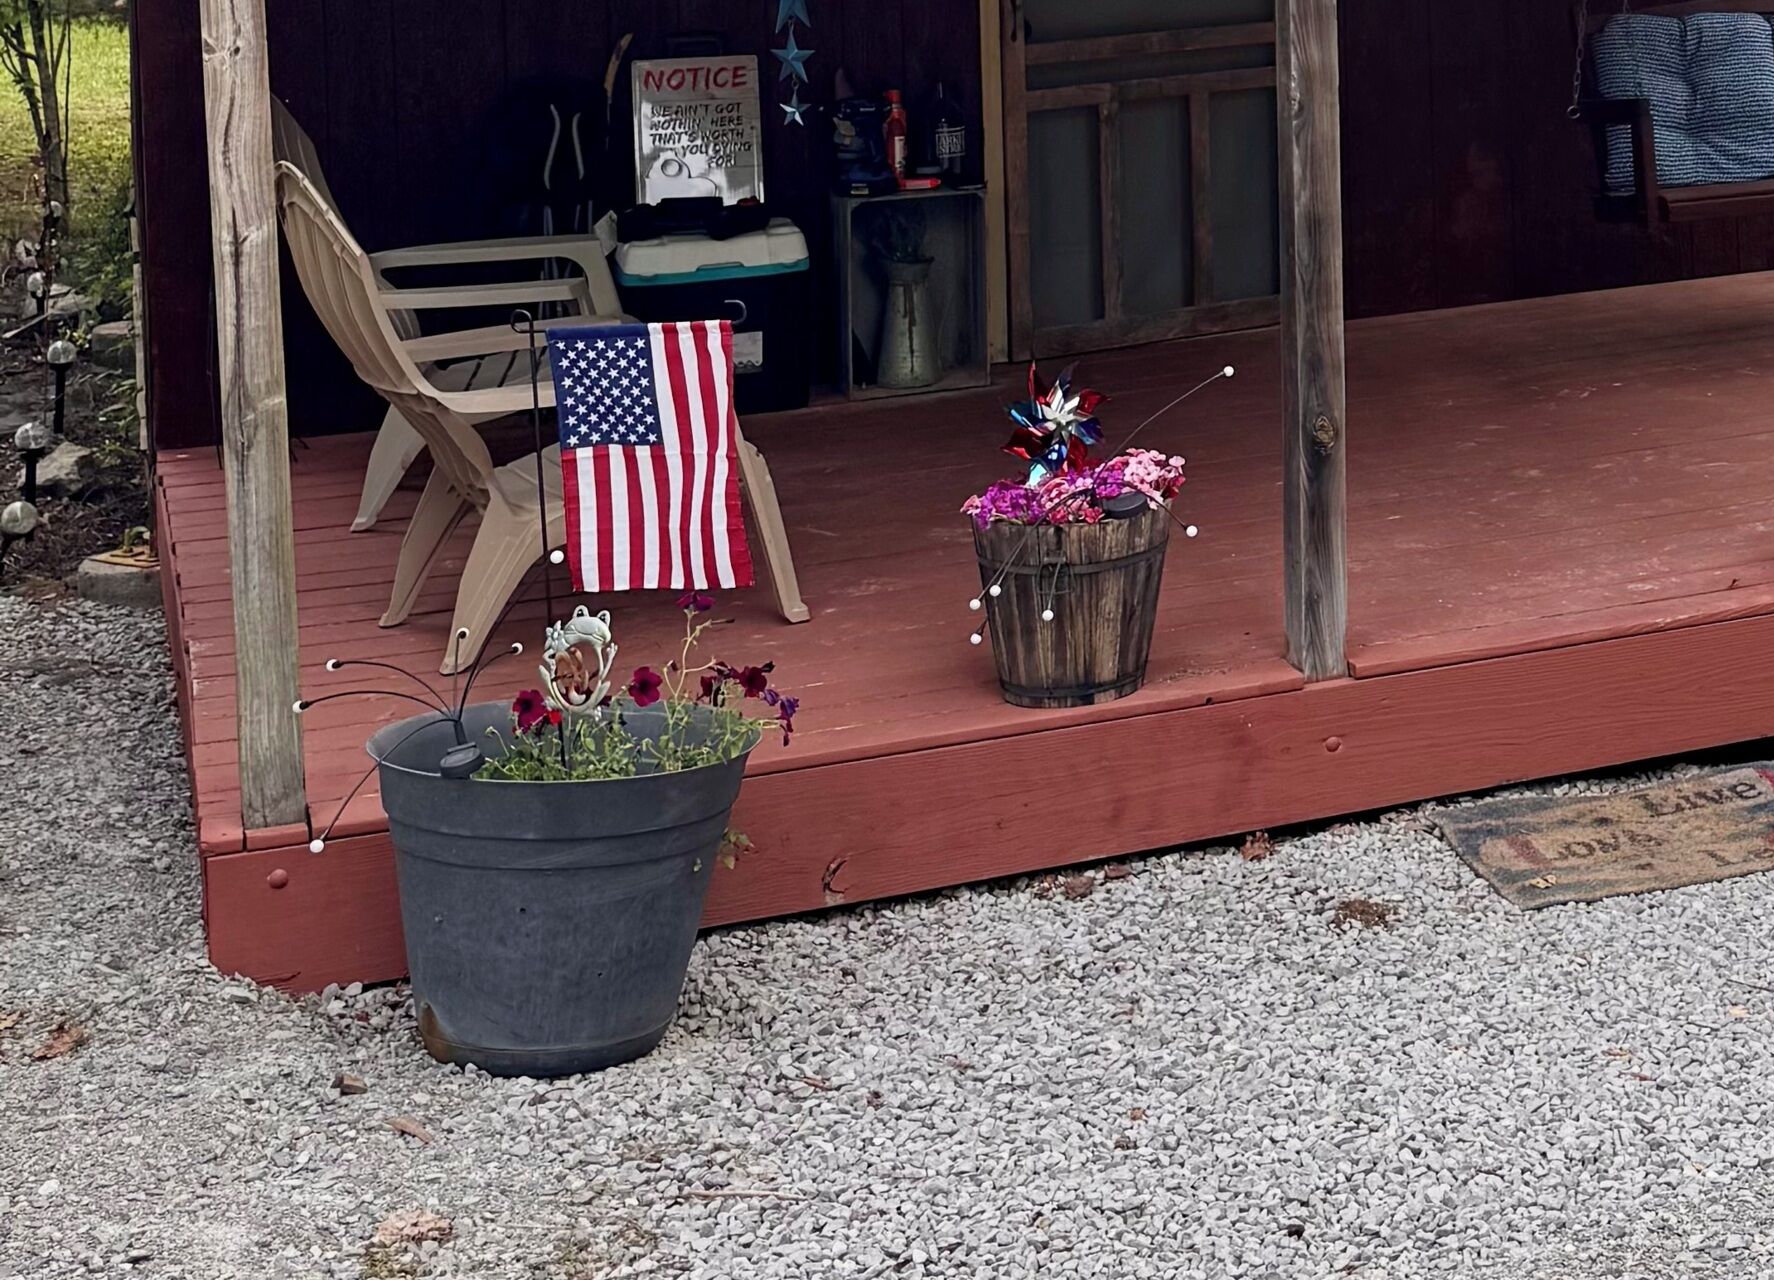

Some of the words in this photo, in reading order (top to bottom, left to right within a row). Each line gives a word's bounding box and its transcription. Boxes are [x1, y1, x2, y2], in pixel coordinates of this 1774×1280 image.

[643, 66, 747, 92] NOTICE
[651, 105, 673, 117] WE
[715, 102, 742, 114] GOT
[711, 115, 744, 127] HERE
[649, 130, 697, 145] THAT'S
[700, 128, 745, 141] WORTH
[681, 144, 709, 158] YOU
[712, 141, 752, 154] DYING
